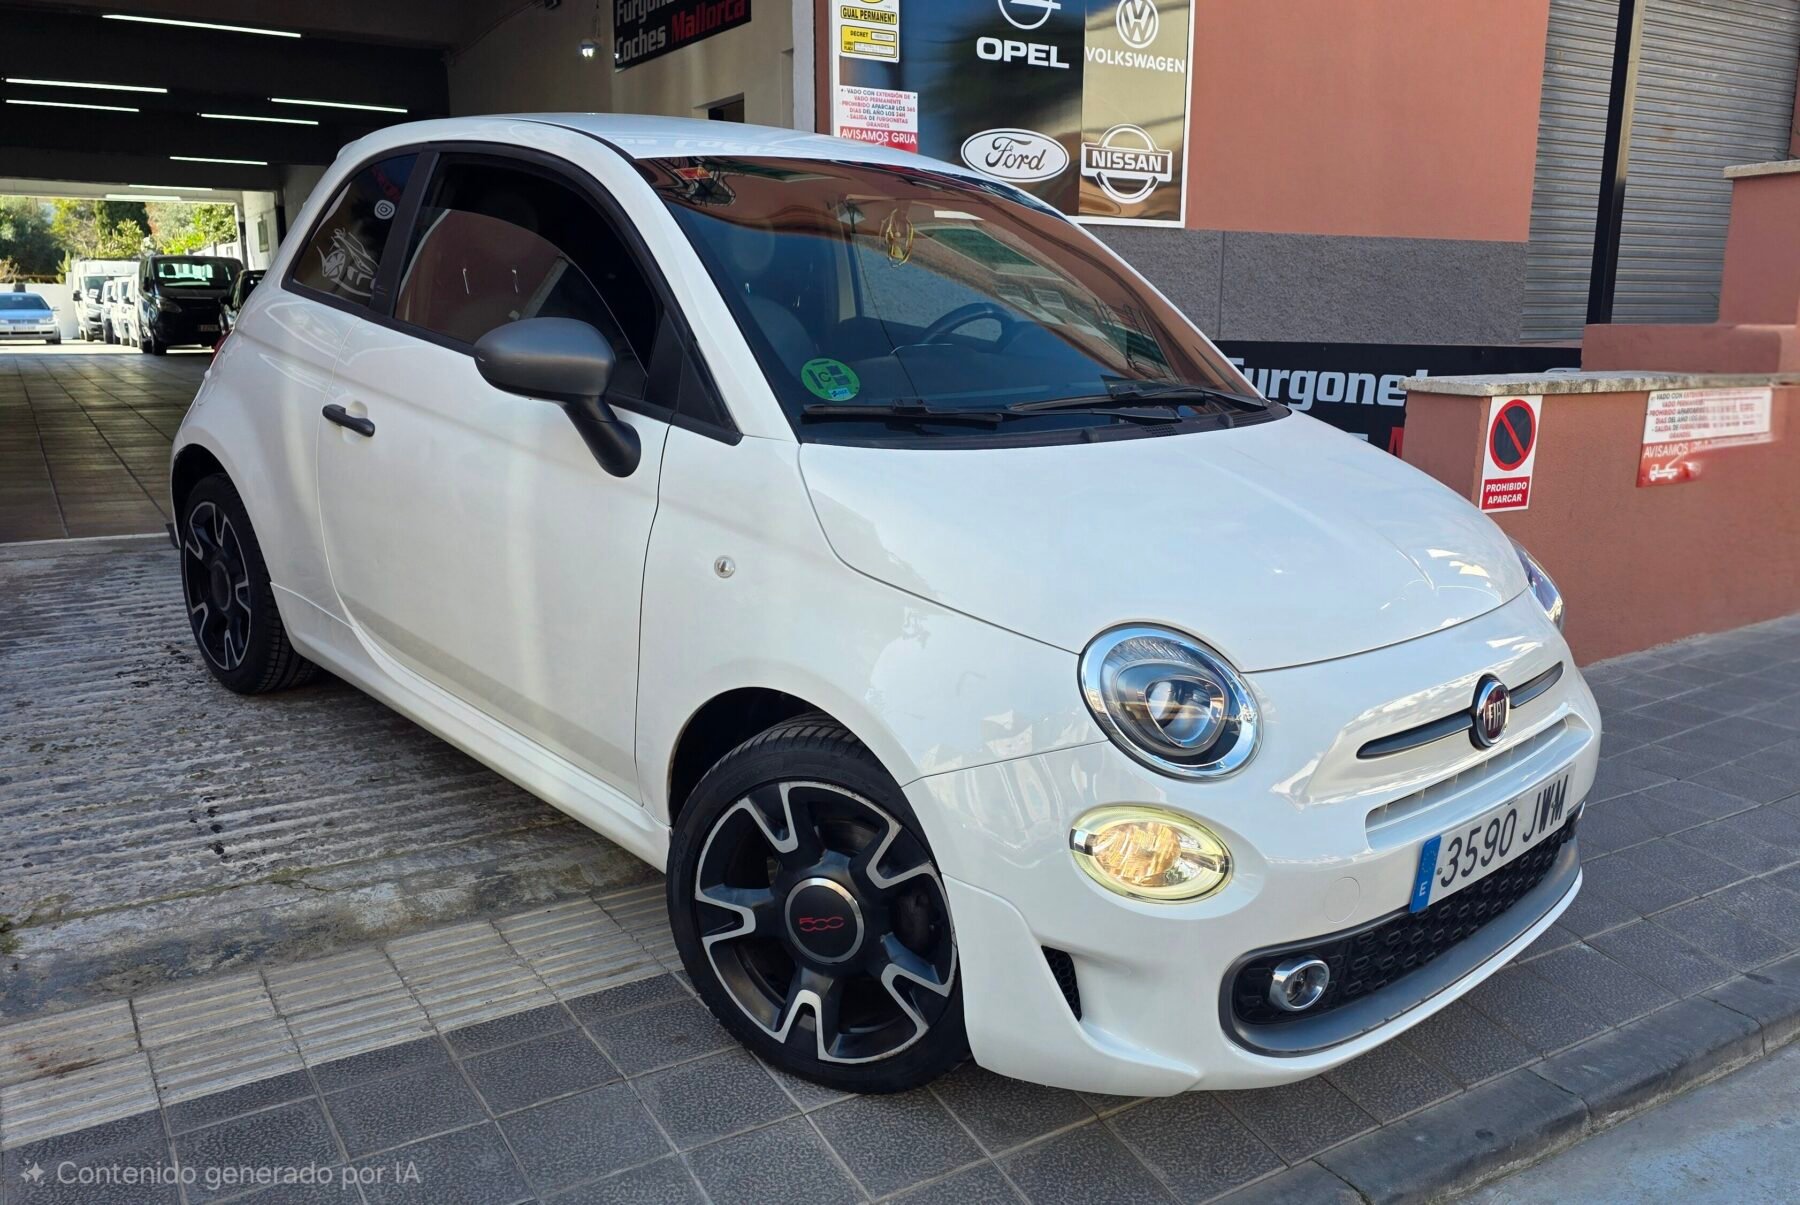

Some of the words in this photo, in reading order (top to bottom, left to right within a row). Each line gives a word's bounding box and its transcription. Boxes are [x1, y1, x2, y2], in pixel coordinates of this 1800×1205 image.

[616, 0, 675, 27] Furgo
[842, 7, 858, 19] GUAL
[860, 10, 895, 23] PERMANENT
[616, 25, 666, 64] Coches
[671, 0, 745, 44] Mallorca
[850, 30, 869, 38] DECRET
[976, 36, 1070, 69] OPEL
[1085, 46, 1185, 73] VOLKSWAGEN
[842, 100, 870, 108] PROHIBIDO
[870, 97, 902, 105] PERMANENTE
[876, 116, 909, 124] FURGONETAS
[841, 128, 889, 142] AVISAMOS
[891, 132, 917, 145] GRUA
[985, 136, 1047, 171] Ford
[1091, 150, 1162, 172] NISSAN
[1228, 357, 1429, 411] urgone
[1643, 443, 1689, 458] AVISAMOS
[1486, 482, 1527, 493] PROHIBIDO
[1487, 493, 1522, 505] APARCAR
[1488, 698, 1505, 731] FIAT
[1440, 808, 1517, 888] 3590
[1522, 773, 1569, 843] JWM
[1419, 880, 1428, 896] E
[799, 916, 845, 932] 500
